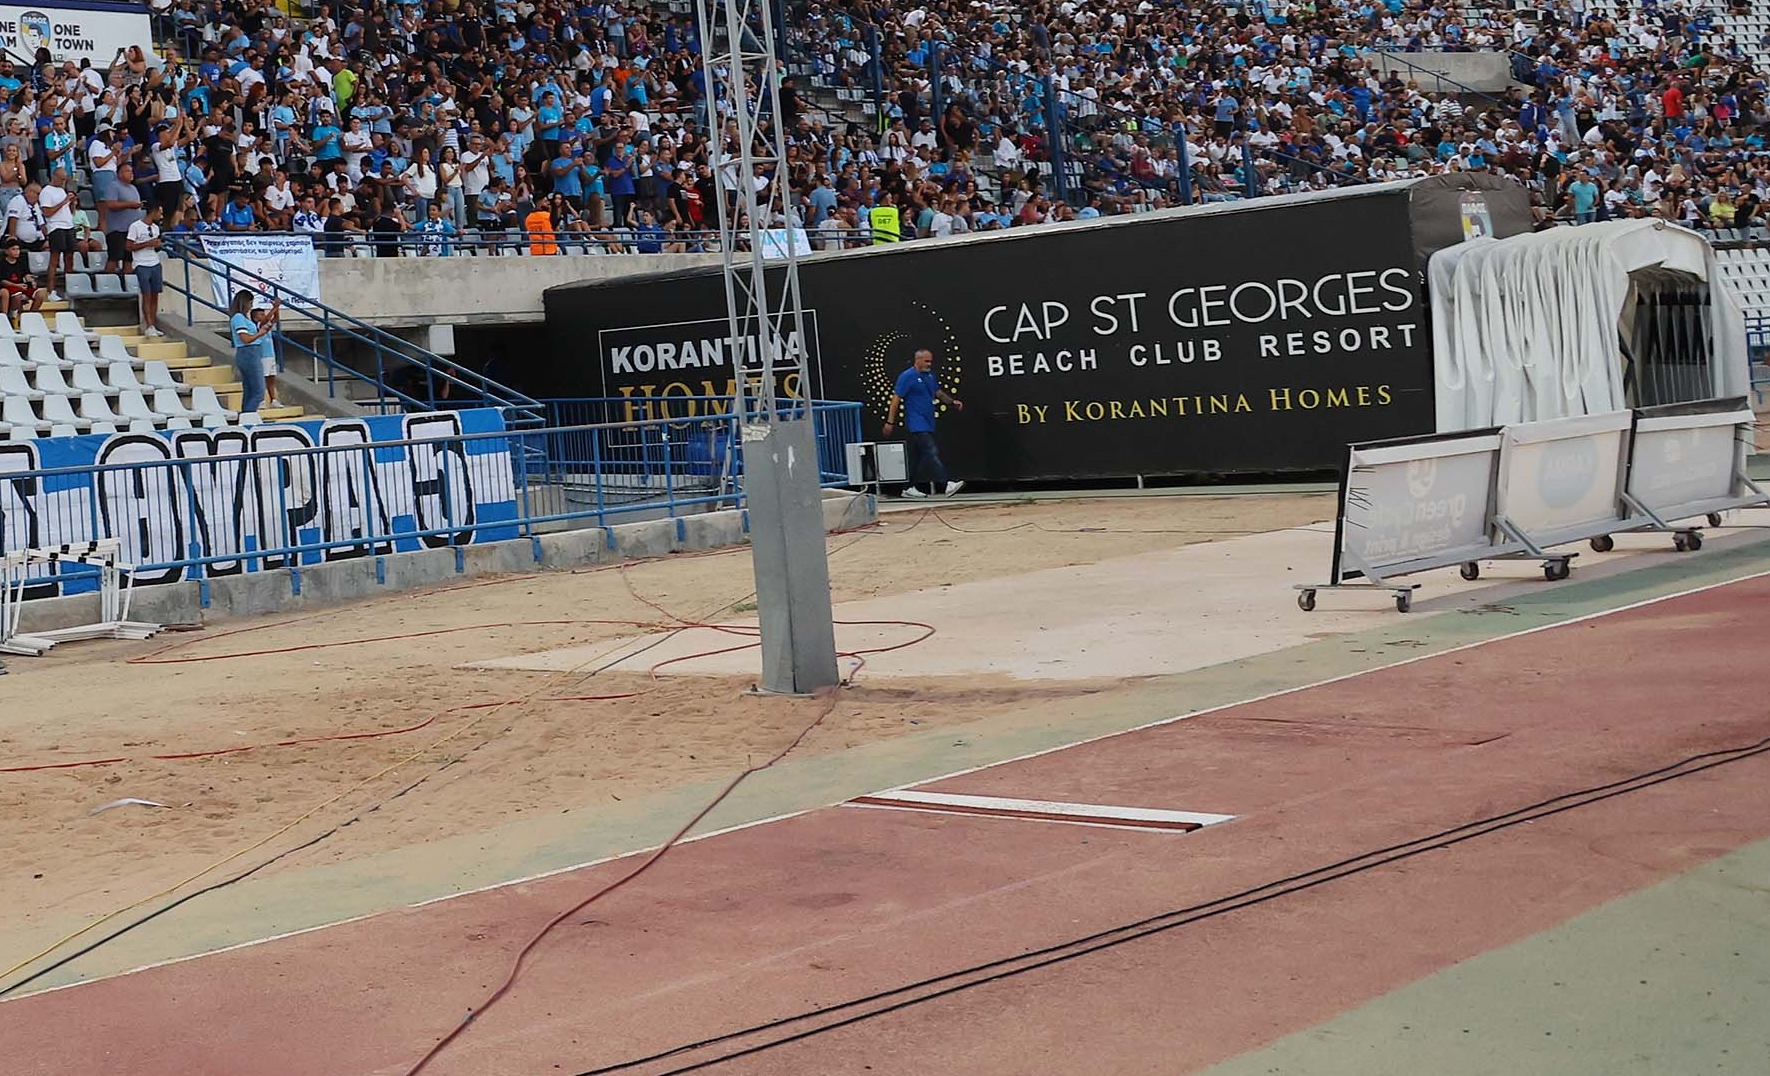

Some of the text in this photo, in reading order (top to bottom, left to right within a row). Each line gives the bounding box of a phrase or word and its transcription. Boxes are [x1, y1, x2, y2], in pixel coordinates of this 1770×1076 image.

[53, 24, 81, 37] ONE
[54, 37, 94, 51] TOWN
[983, 267, 1415, 344] CAP ST GEORGES
[987, 324, 1418, 378] BEACH CLUB RESORT
